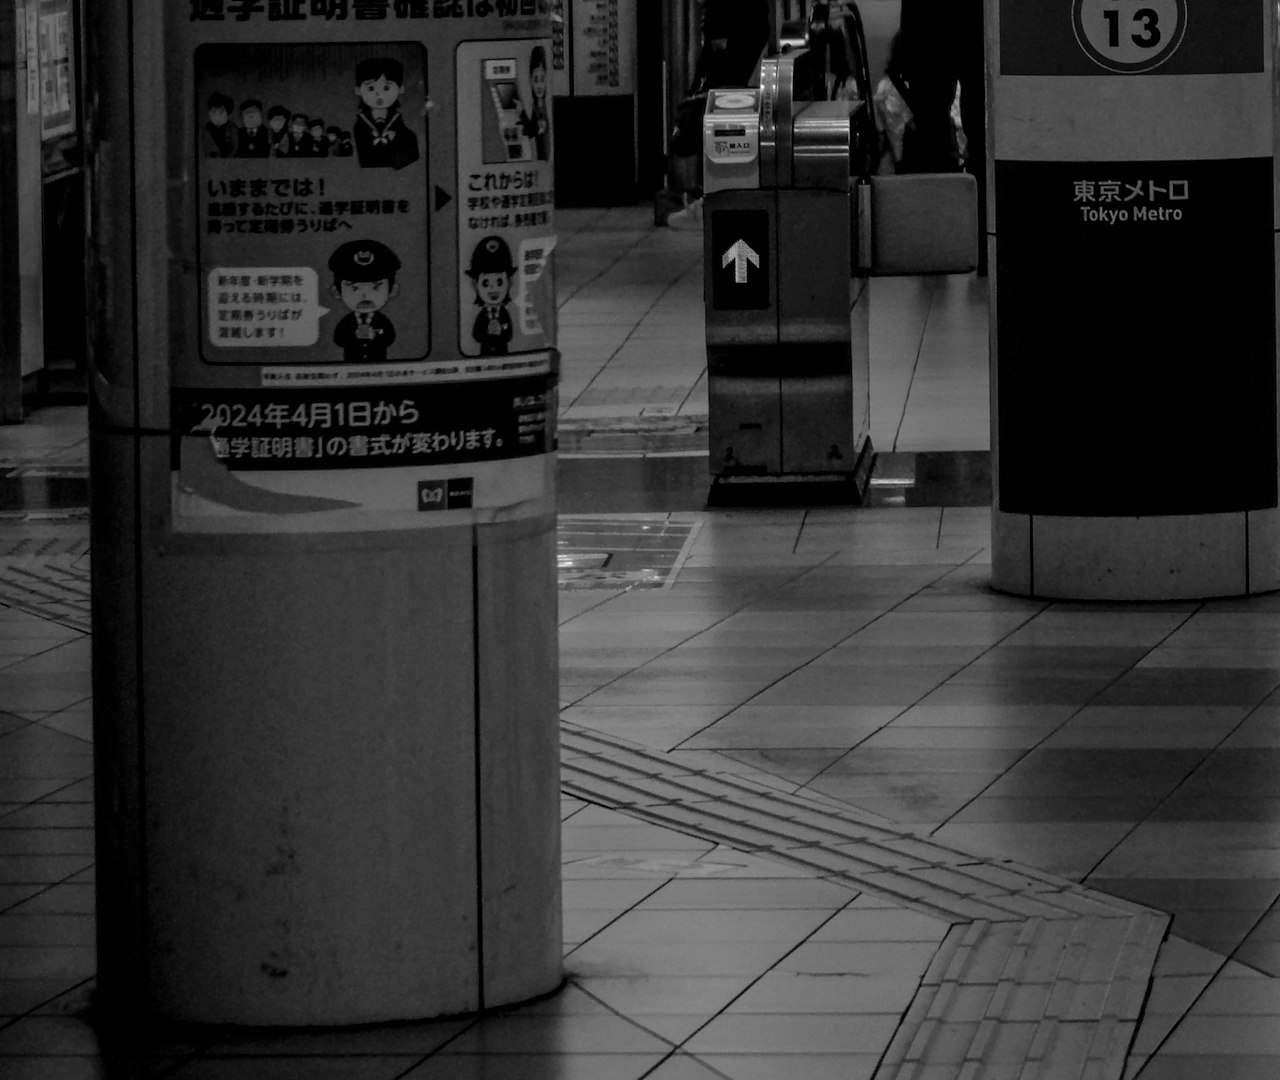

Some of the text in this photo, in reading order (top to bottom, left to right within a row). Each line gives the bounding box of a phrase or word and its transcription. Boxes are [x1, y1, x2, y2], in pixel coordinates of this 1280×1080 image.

[1103, 8, 1161, 48] 13
[1072, 179, 1190, 203] 東京メトロ
[1080, 205, 1183, 226] Tokyo Metro
[200, 400, 420, 429] 2024年4月1日から
